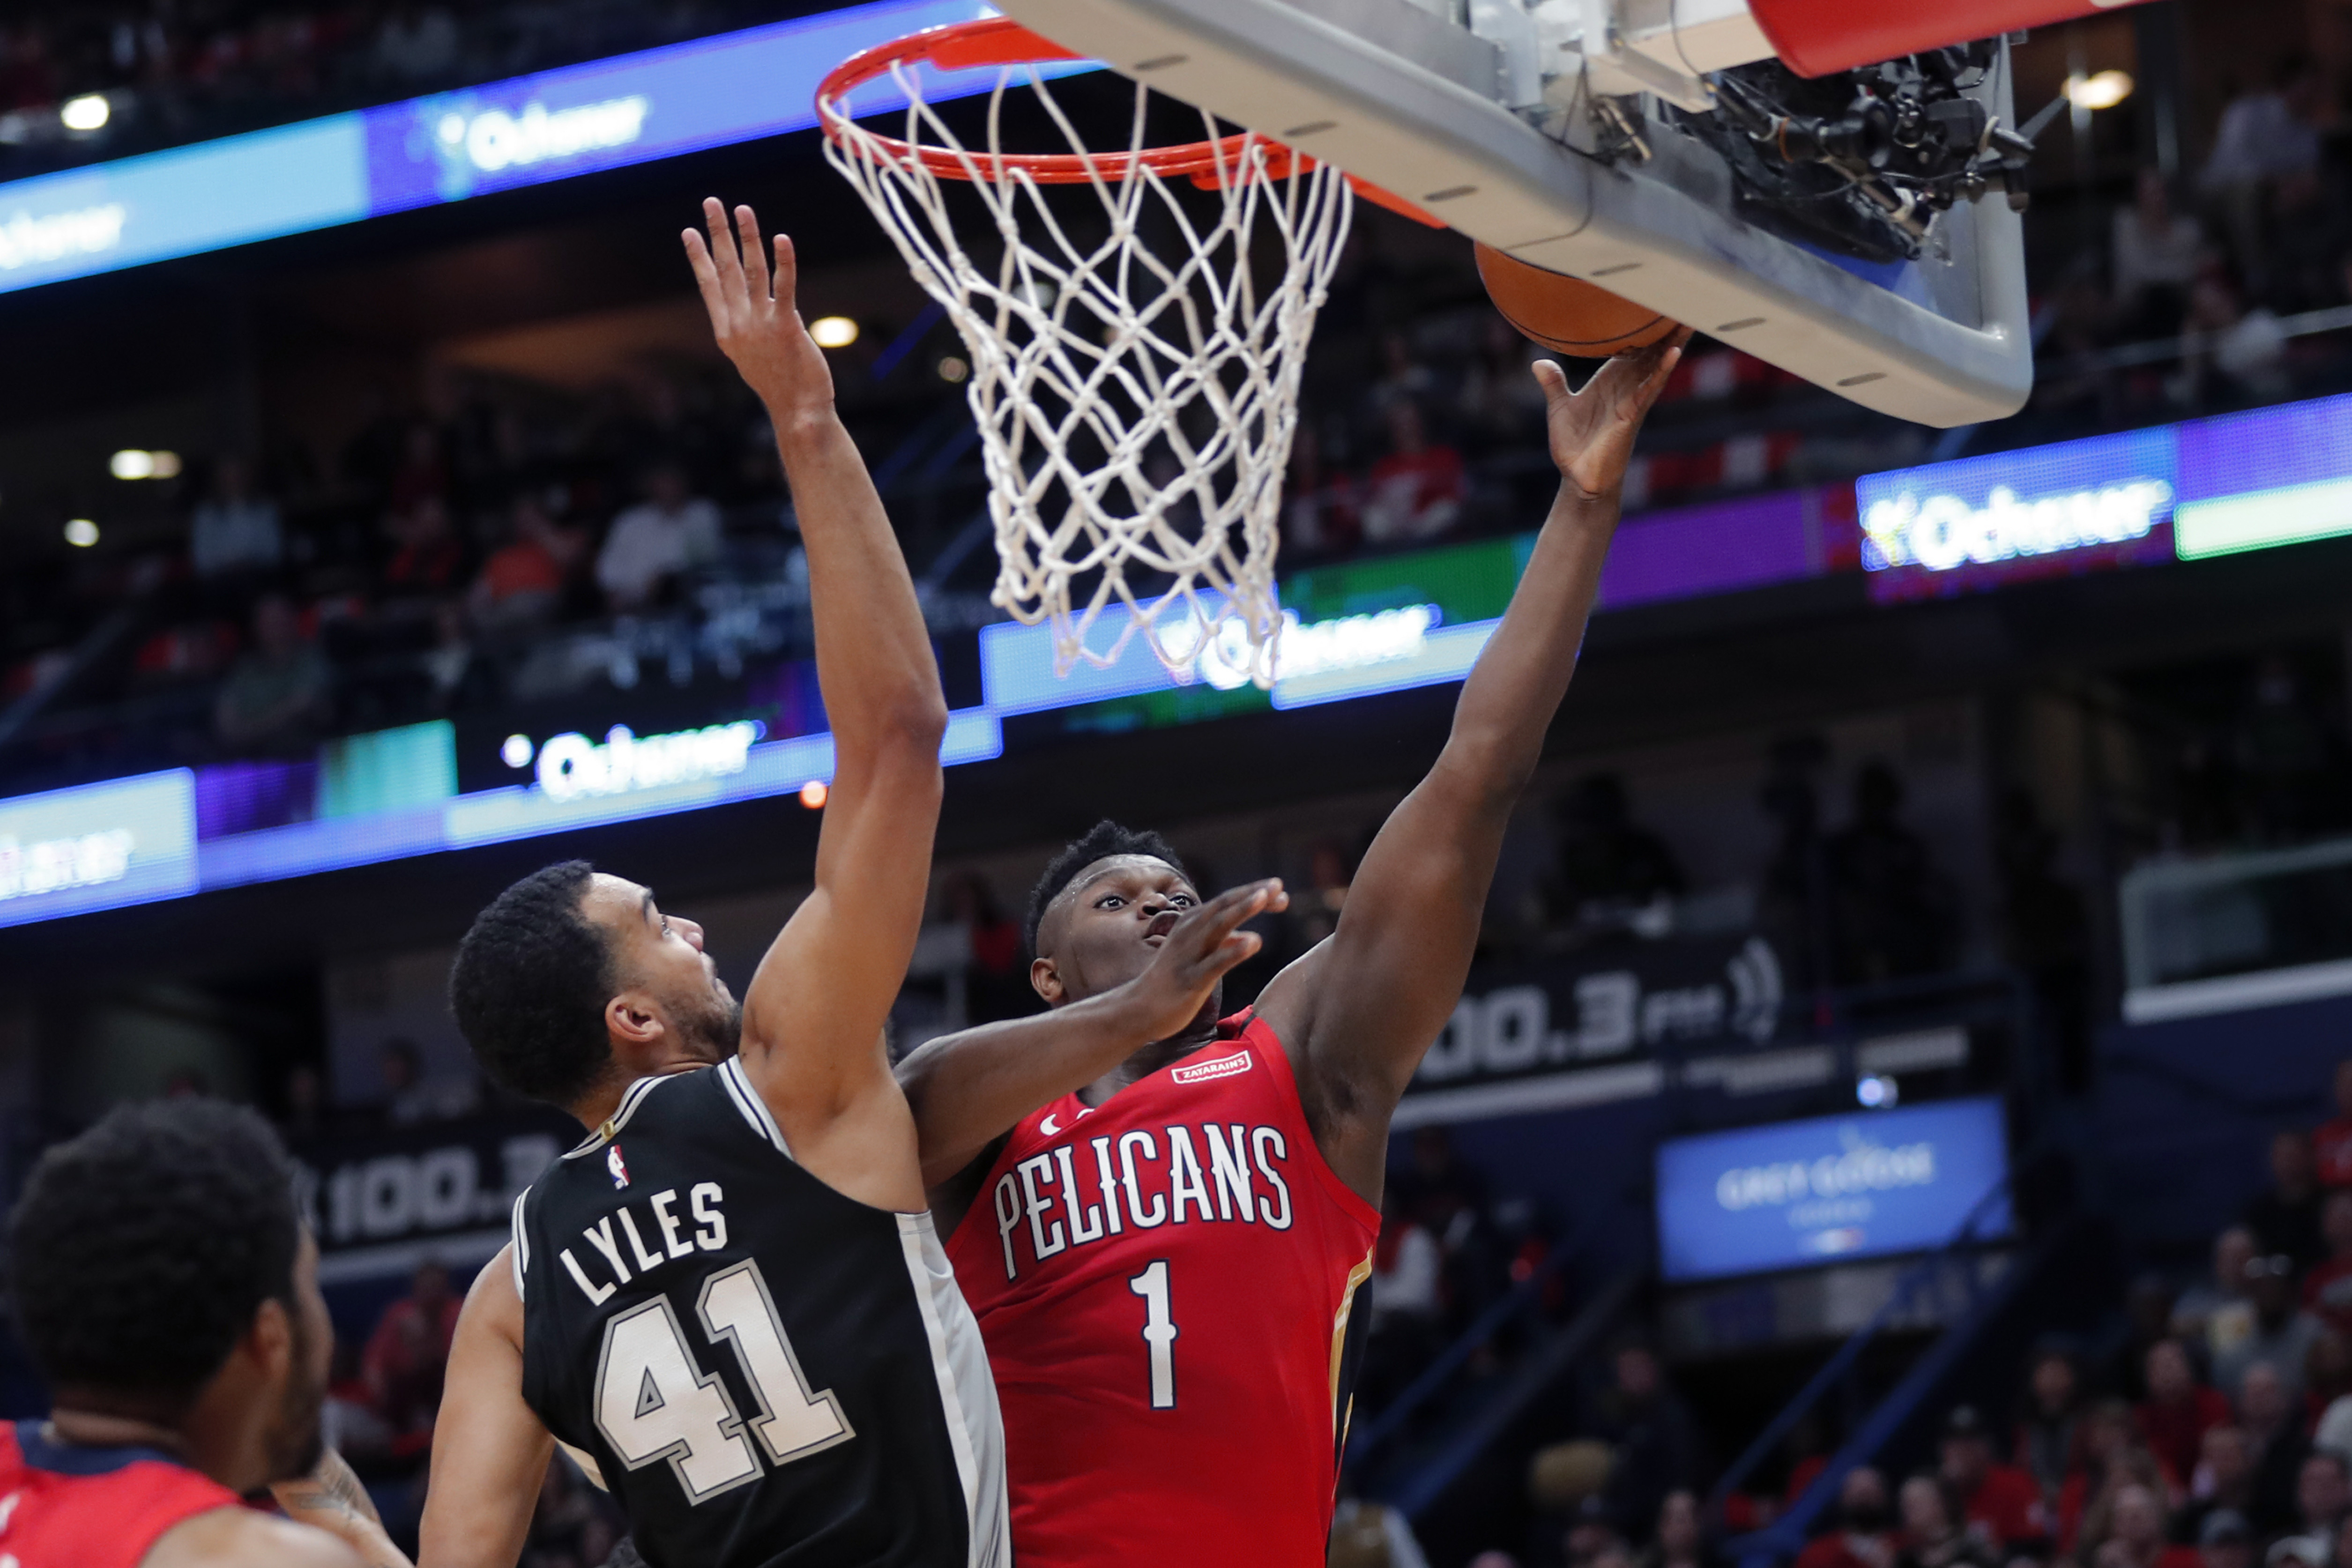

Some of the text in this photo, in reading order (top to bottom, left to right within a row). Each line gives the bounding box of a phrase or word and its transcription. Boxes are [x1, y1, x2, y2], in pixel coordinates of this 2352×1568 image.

[559, 1181, 728, 1307] LYLES
[994, 1122, 1294, 1283] PELICANS
[593, 1256, 856, 1507] 41
[1128, 1258, 1179, 1410] 1
